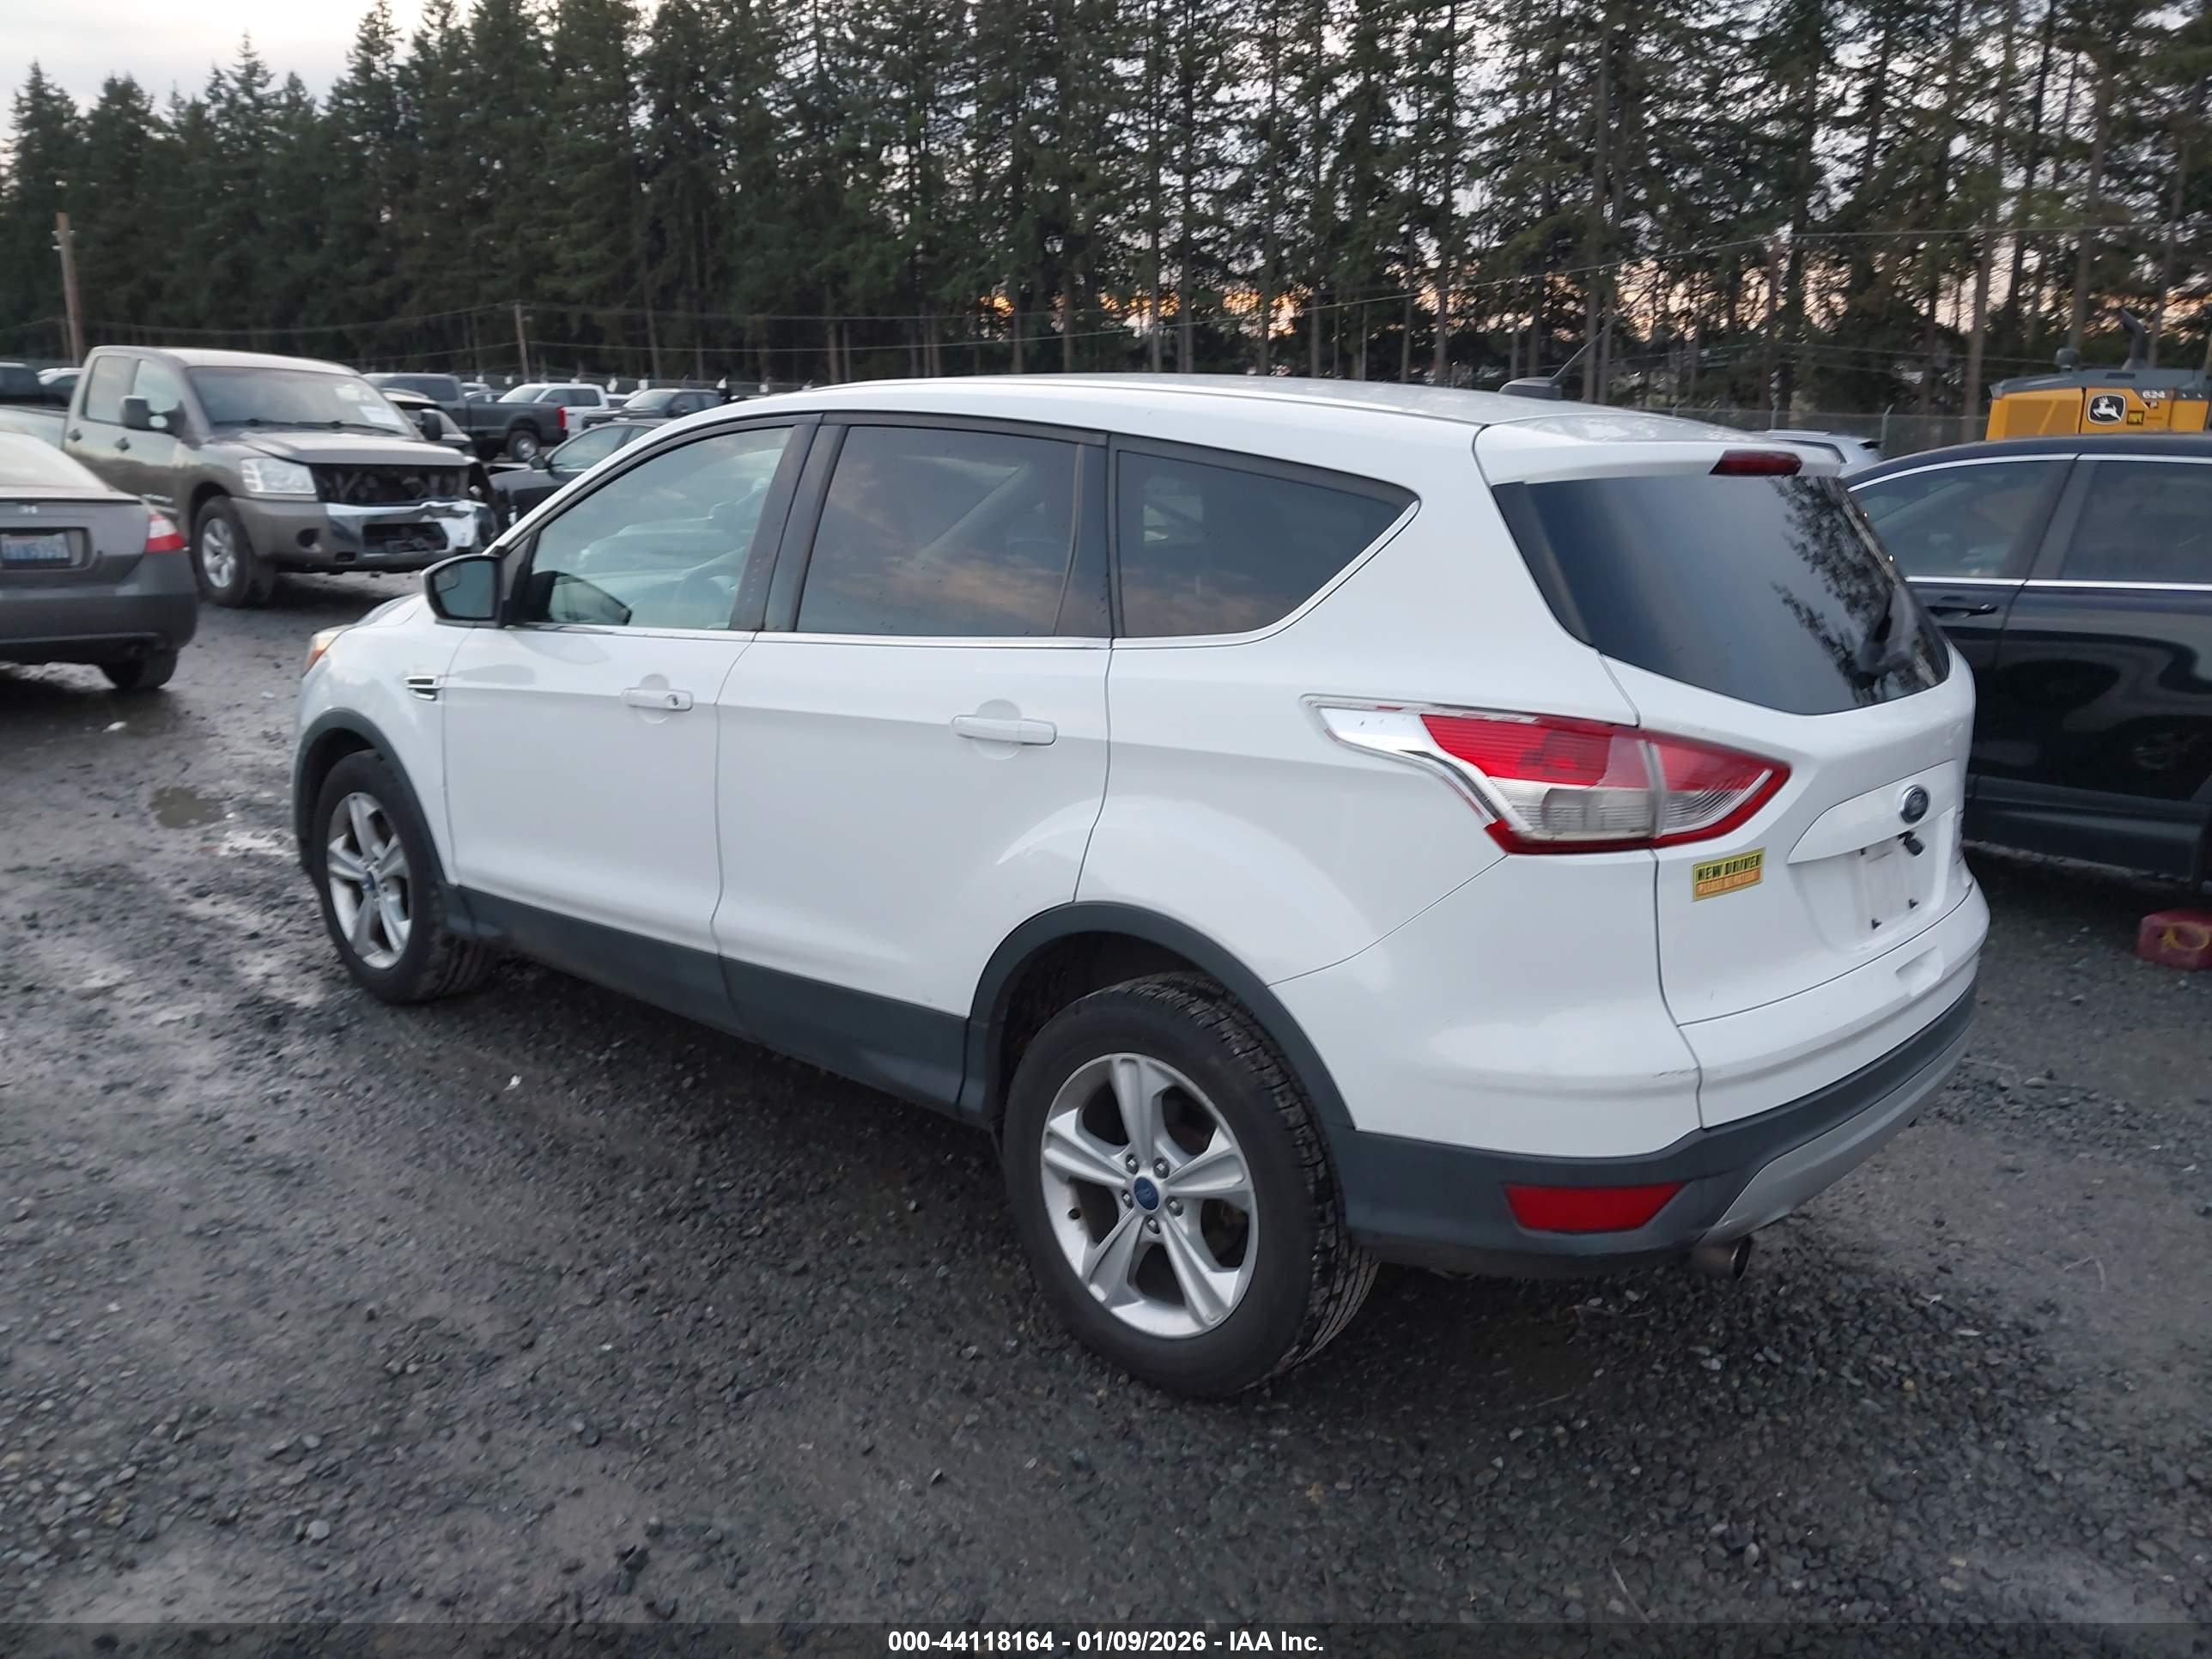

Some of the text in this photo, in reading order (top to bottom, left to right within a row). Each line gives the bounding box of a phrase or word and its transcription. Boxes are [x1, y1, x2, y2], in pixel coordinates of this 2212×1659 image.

[2142, 389, 2166, 399] 624
[1698, 862, 1723, 881] NEW
[1724, 854, 1761, 876] DRIVER
